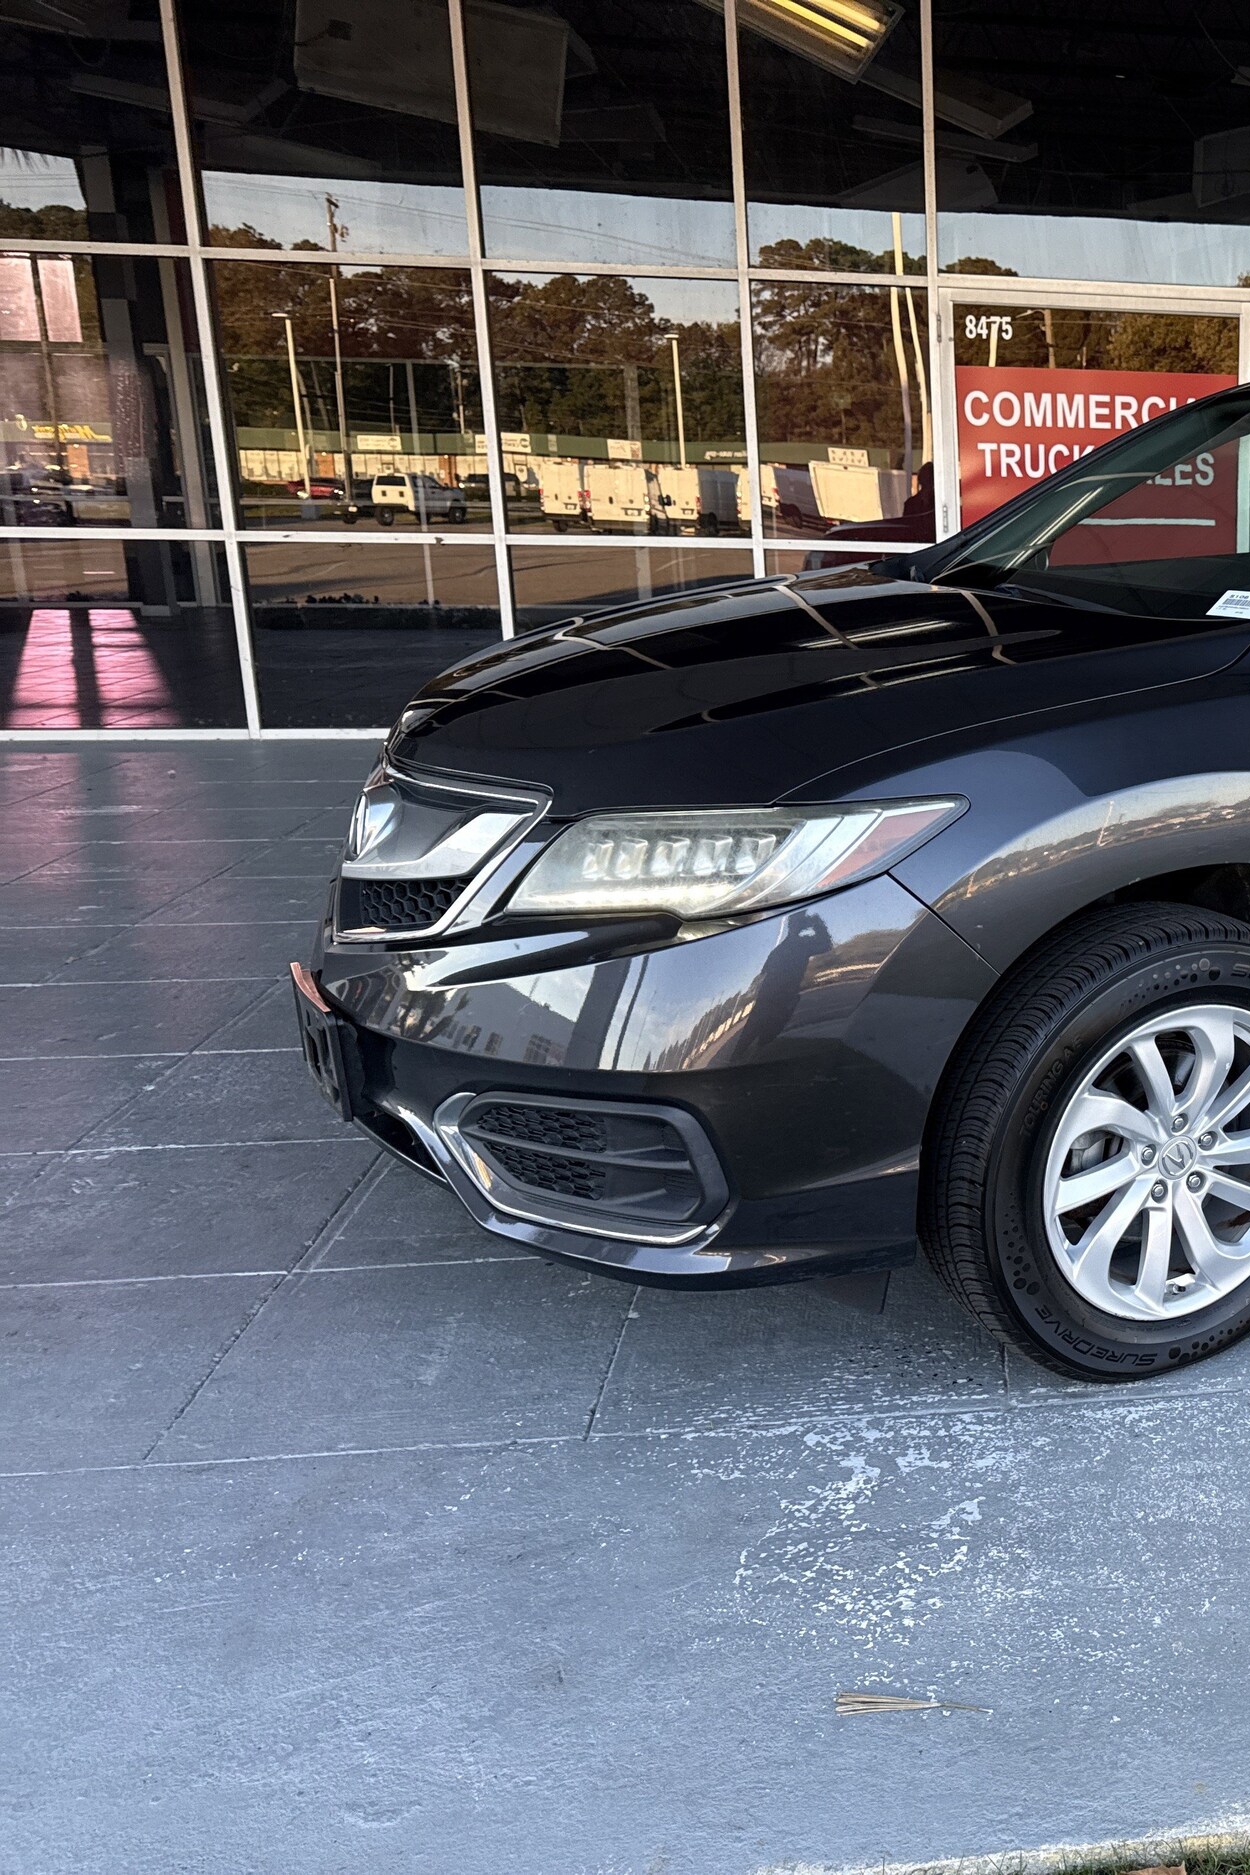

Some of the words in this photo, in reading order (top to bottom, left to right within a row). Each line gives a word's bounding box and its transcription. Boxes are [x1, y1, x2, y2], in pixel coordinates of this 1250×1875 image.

[965, 314, 1013, 340] 8475
[963, 390, 1197, 430] COMMERC
[1034, 1304, 1158, 1367] SUREDRIVE
